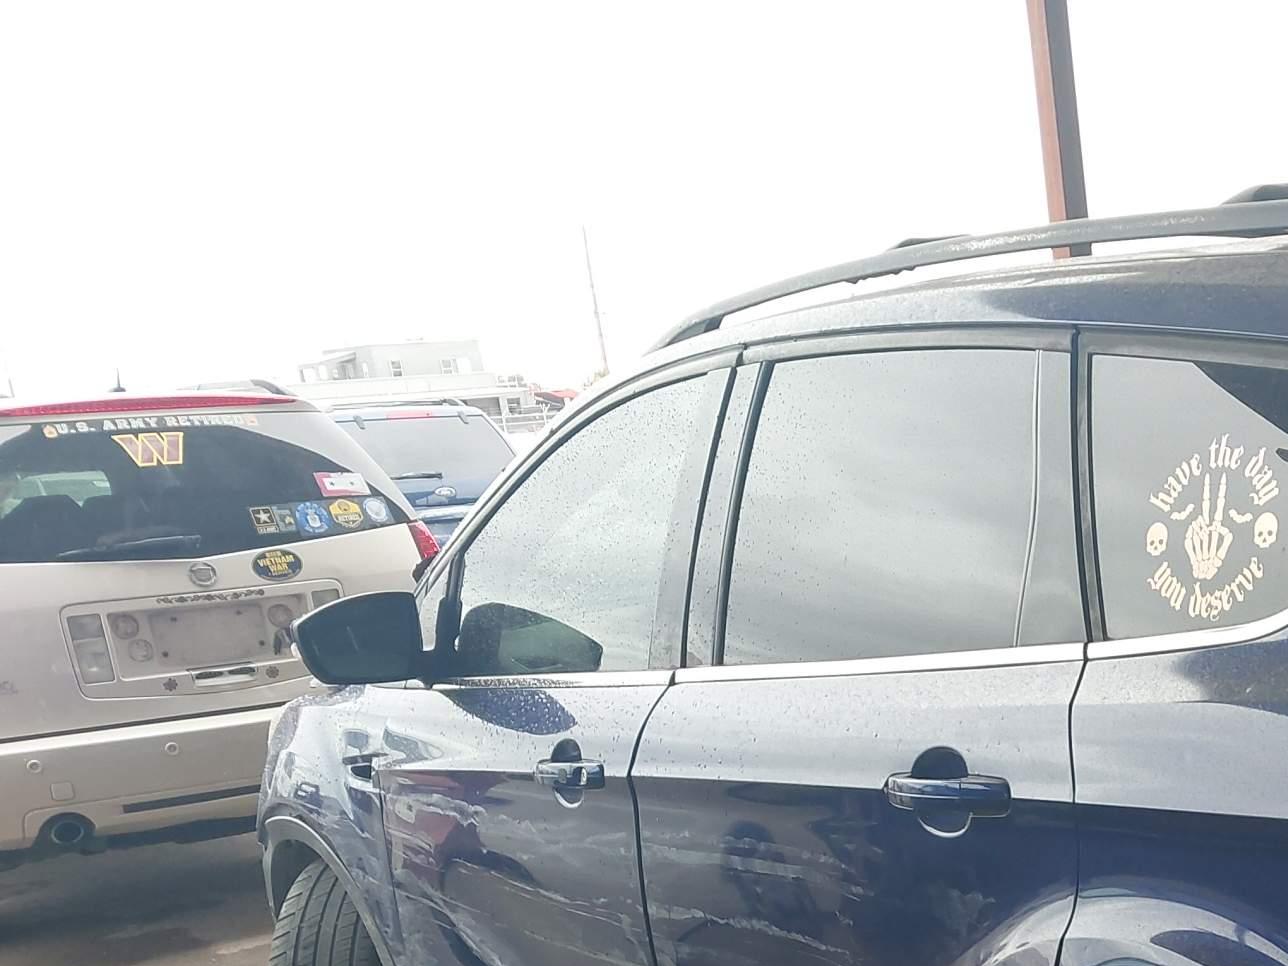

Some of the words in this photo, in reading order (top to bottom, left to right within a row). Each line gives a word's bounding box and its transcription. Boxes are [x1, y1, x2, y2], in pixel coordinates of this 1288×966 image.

[55, 421, 96, 434] U.S.
[103, 416, 159, 431] ARMY
[164, 415, 245, 426] RETIRED
[1149, 454, 1202, 512] have
[1208, 433, 1244, 469] the
[1244, 447, 1279, 506] day
[257, 554, 295, 568] VIETNAM
[268, 562, 288, 573] WAR
[1147, 562, 1186, 611] you
[1189, 557, 1263, 621] deserve
